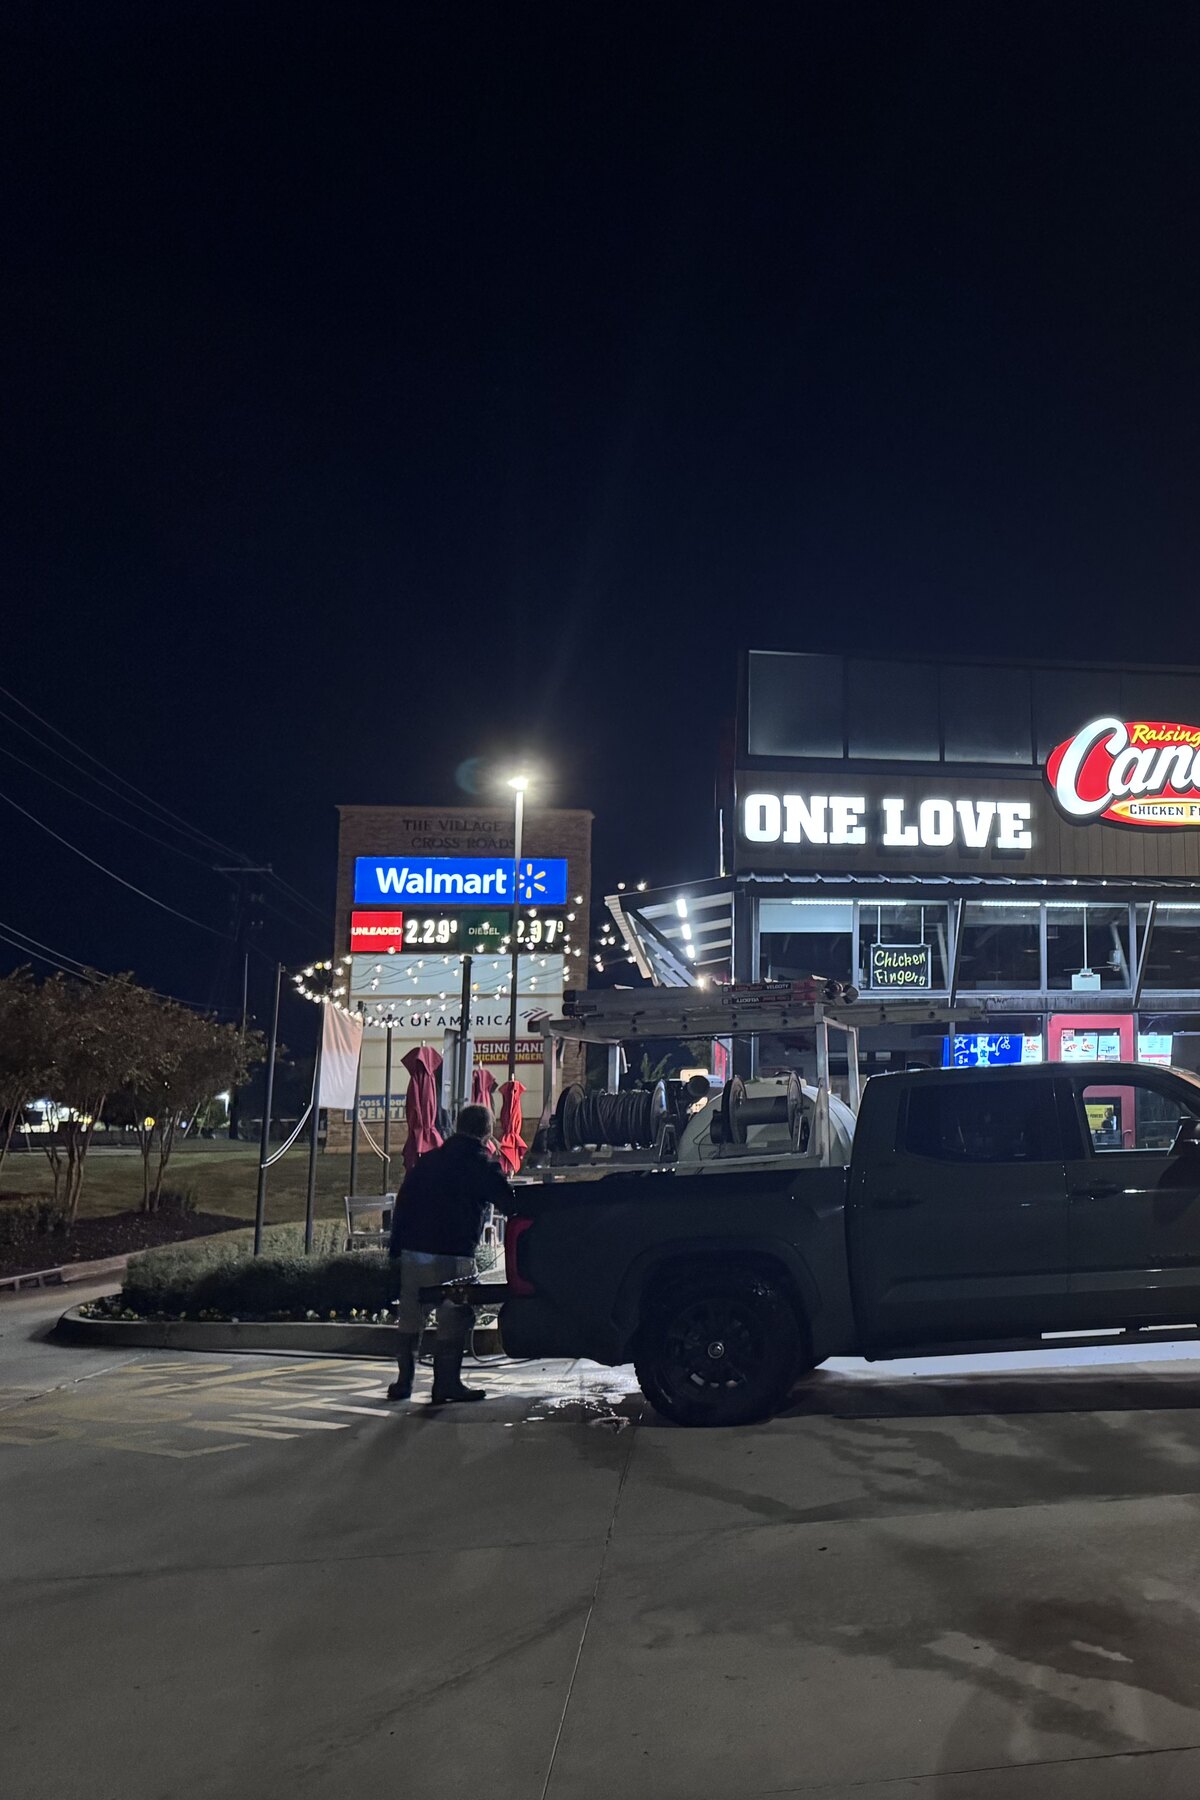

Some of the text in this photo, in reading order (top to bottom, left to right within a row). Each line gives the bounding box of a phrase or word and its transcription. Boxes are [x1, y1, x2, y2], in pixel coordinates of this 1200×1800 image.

[402, 819, 433, 831] THE
[438, 819, 501, 831] VILLAGE
[744, 793, 1033, 850] ONE LOVE
[411, 837, 460, 849] CROSS
[375, 867, 507, 894] Walmart
[351, 927, 402, 936] UNLEADED
[468, 927, 500, 936] DIESEL
[874, 950, 926, 967] Chicken
[874, 969, 926, 986] Fingers
[359, 1097, 381, 1107] ross
[358, 1107, 407, 1119] DENTI
